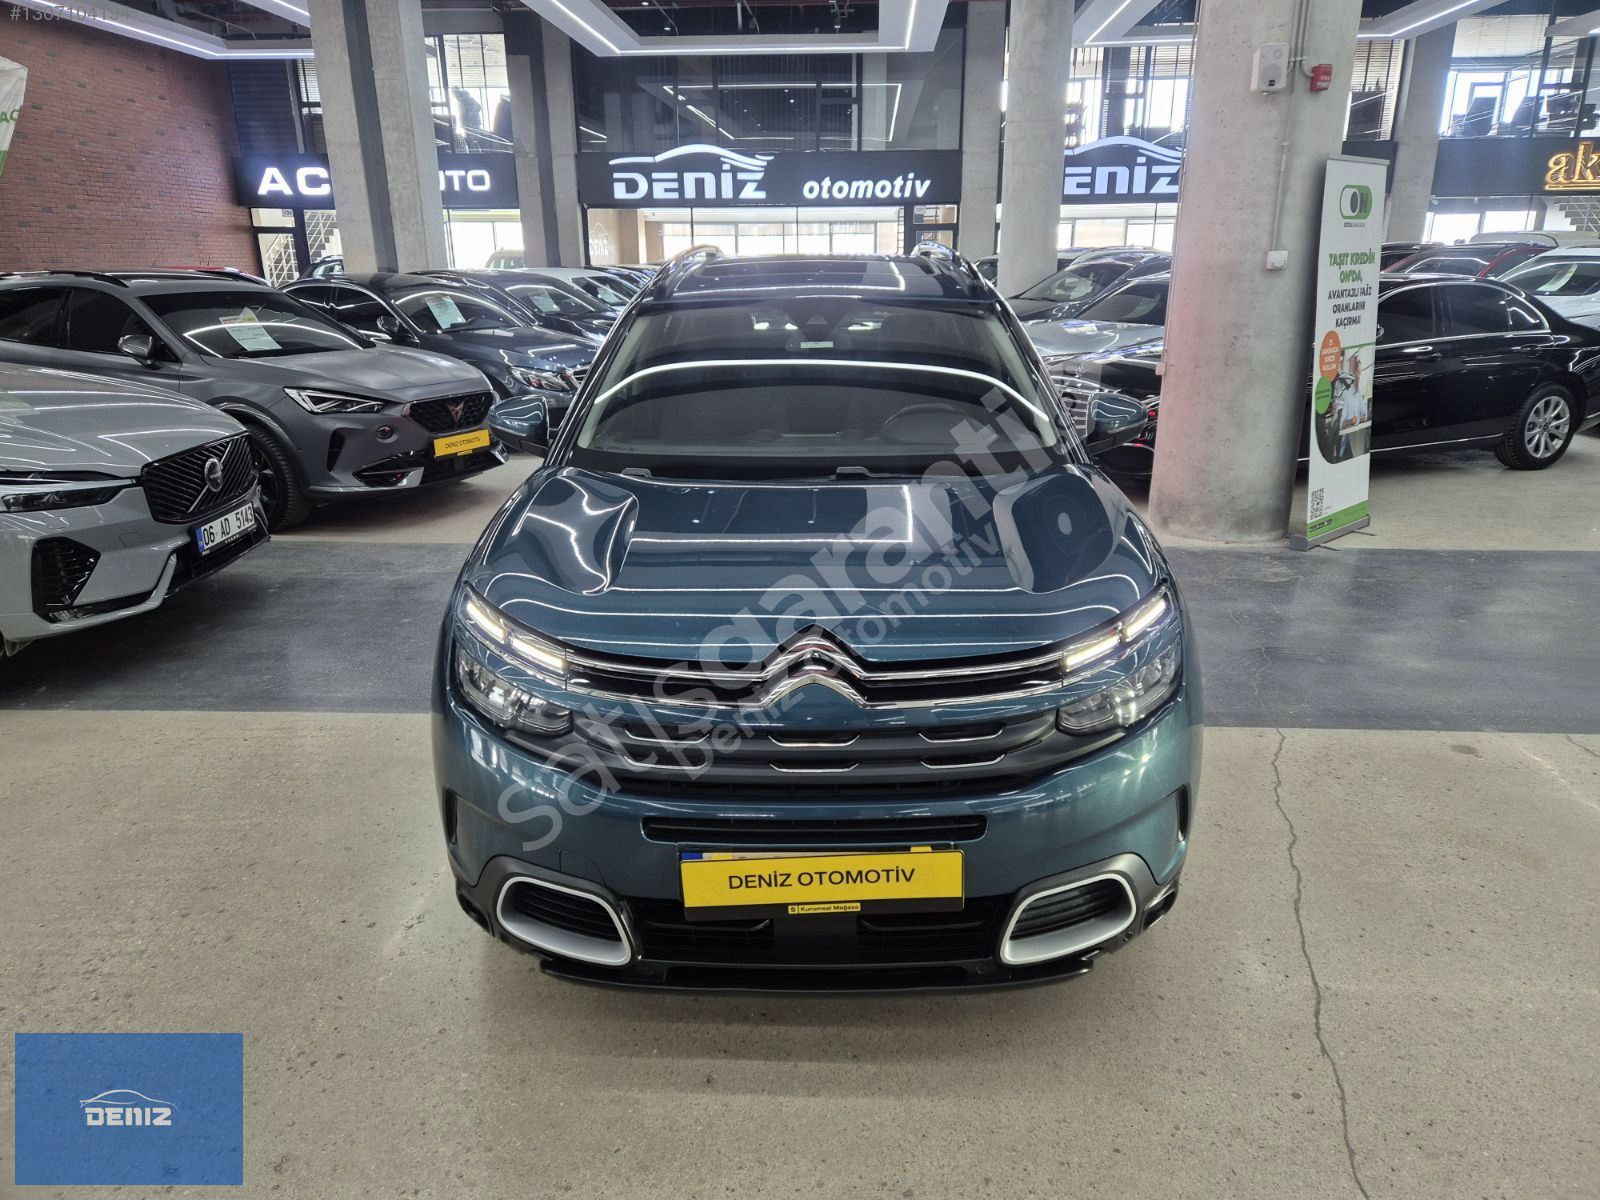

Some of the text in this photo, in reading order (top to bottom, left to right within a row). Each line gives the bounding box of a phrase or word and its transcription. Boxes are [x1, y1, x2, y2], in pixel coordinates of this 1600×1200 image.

[257, 167, 331, 196] AC
[802, 172, 932, 199] otomotiv
[1063, 156, 1182, 195] ENİZ
[203, 525, 215, 547] 06
[220, 518, 231, 538] AD
[235, 505, 254, 529] 5143
[728, 865, 916, 889] DENİZ OTOMOTİV
